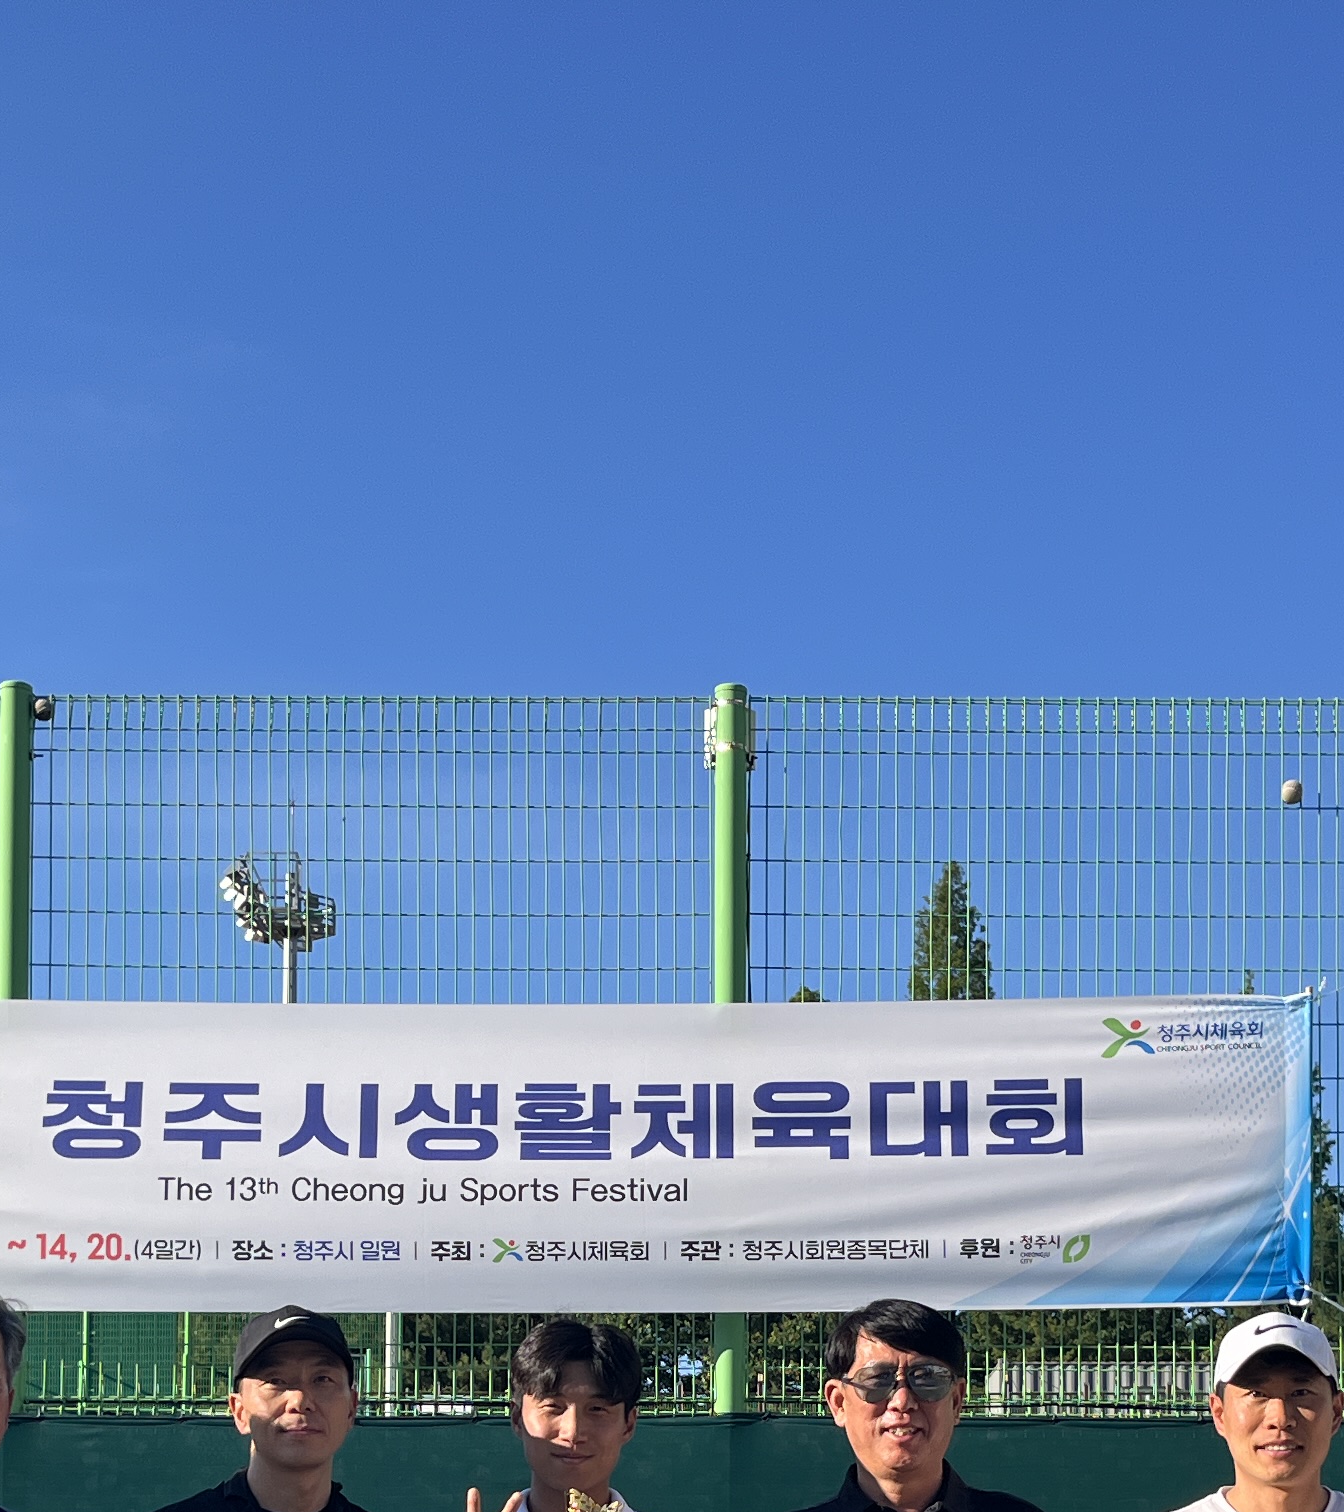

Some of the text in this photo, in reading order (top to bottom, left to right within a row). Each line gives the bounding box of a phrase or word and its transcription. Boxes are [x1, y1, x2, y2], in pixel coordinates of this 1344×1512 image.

[1157, 1021, 1264, 1042] 청주시체육회
[158, 1176, 689, 1206] The 13th Cheong ju Sports Festival
[293, 1240, 354, 1261] 청주시
[360, 1240, 401, 1262] 일원
[525, 1240, 650, 1262] 청주시체육회
[742, 1239, 930, 1260] 청주시회원종목단체
[1020, 1234, 1061, 1250] 청주시
